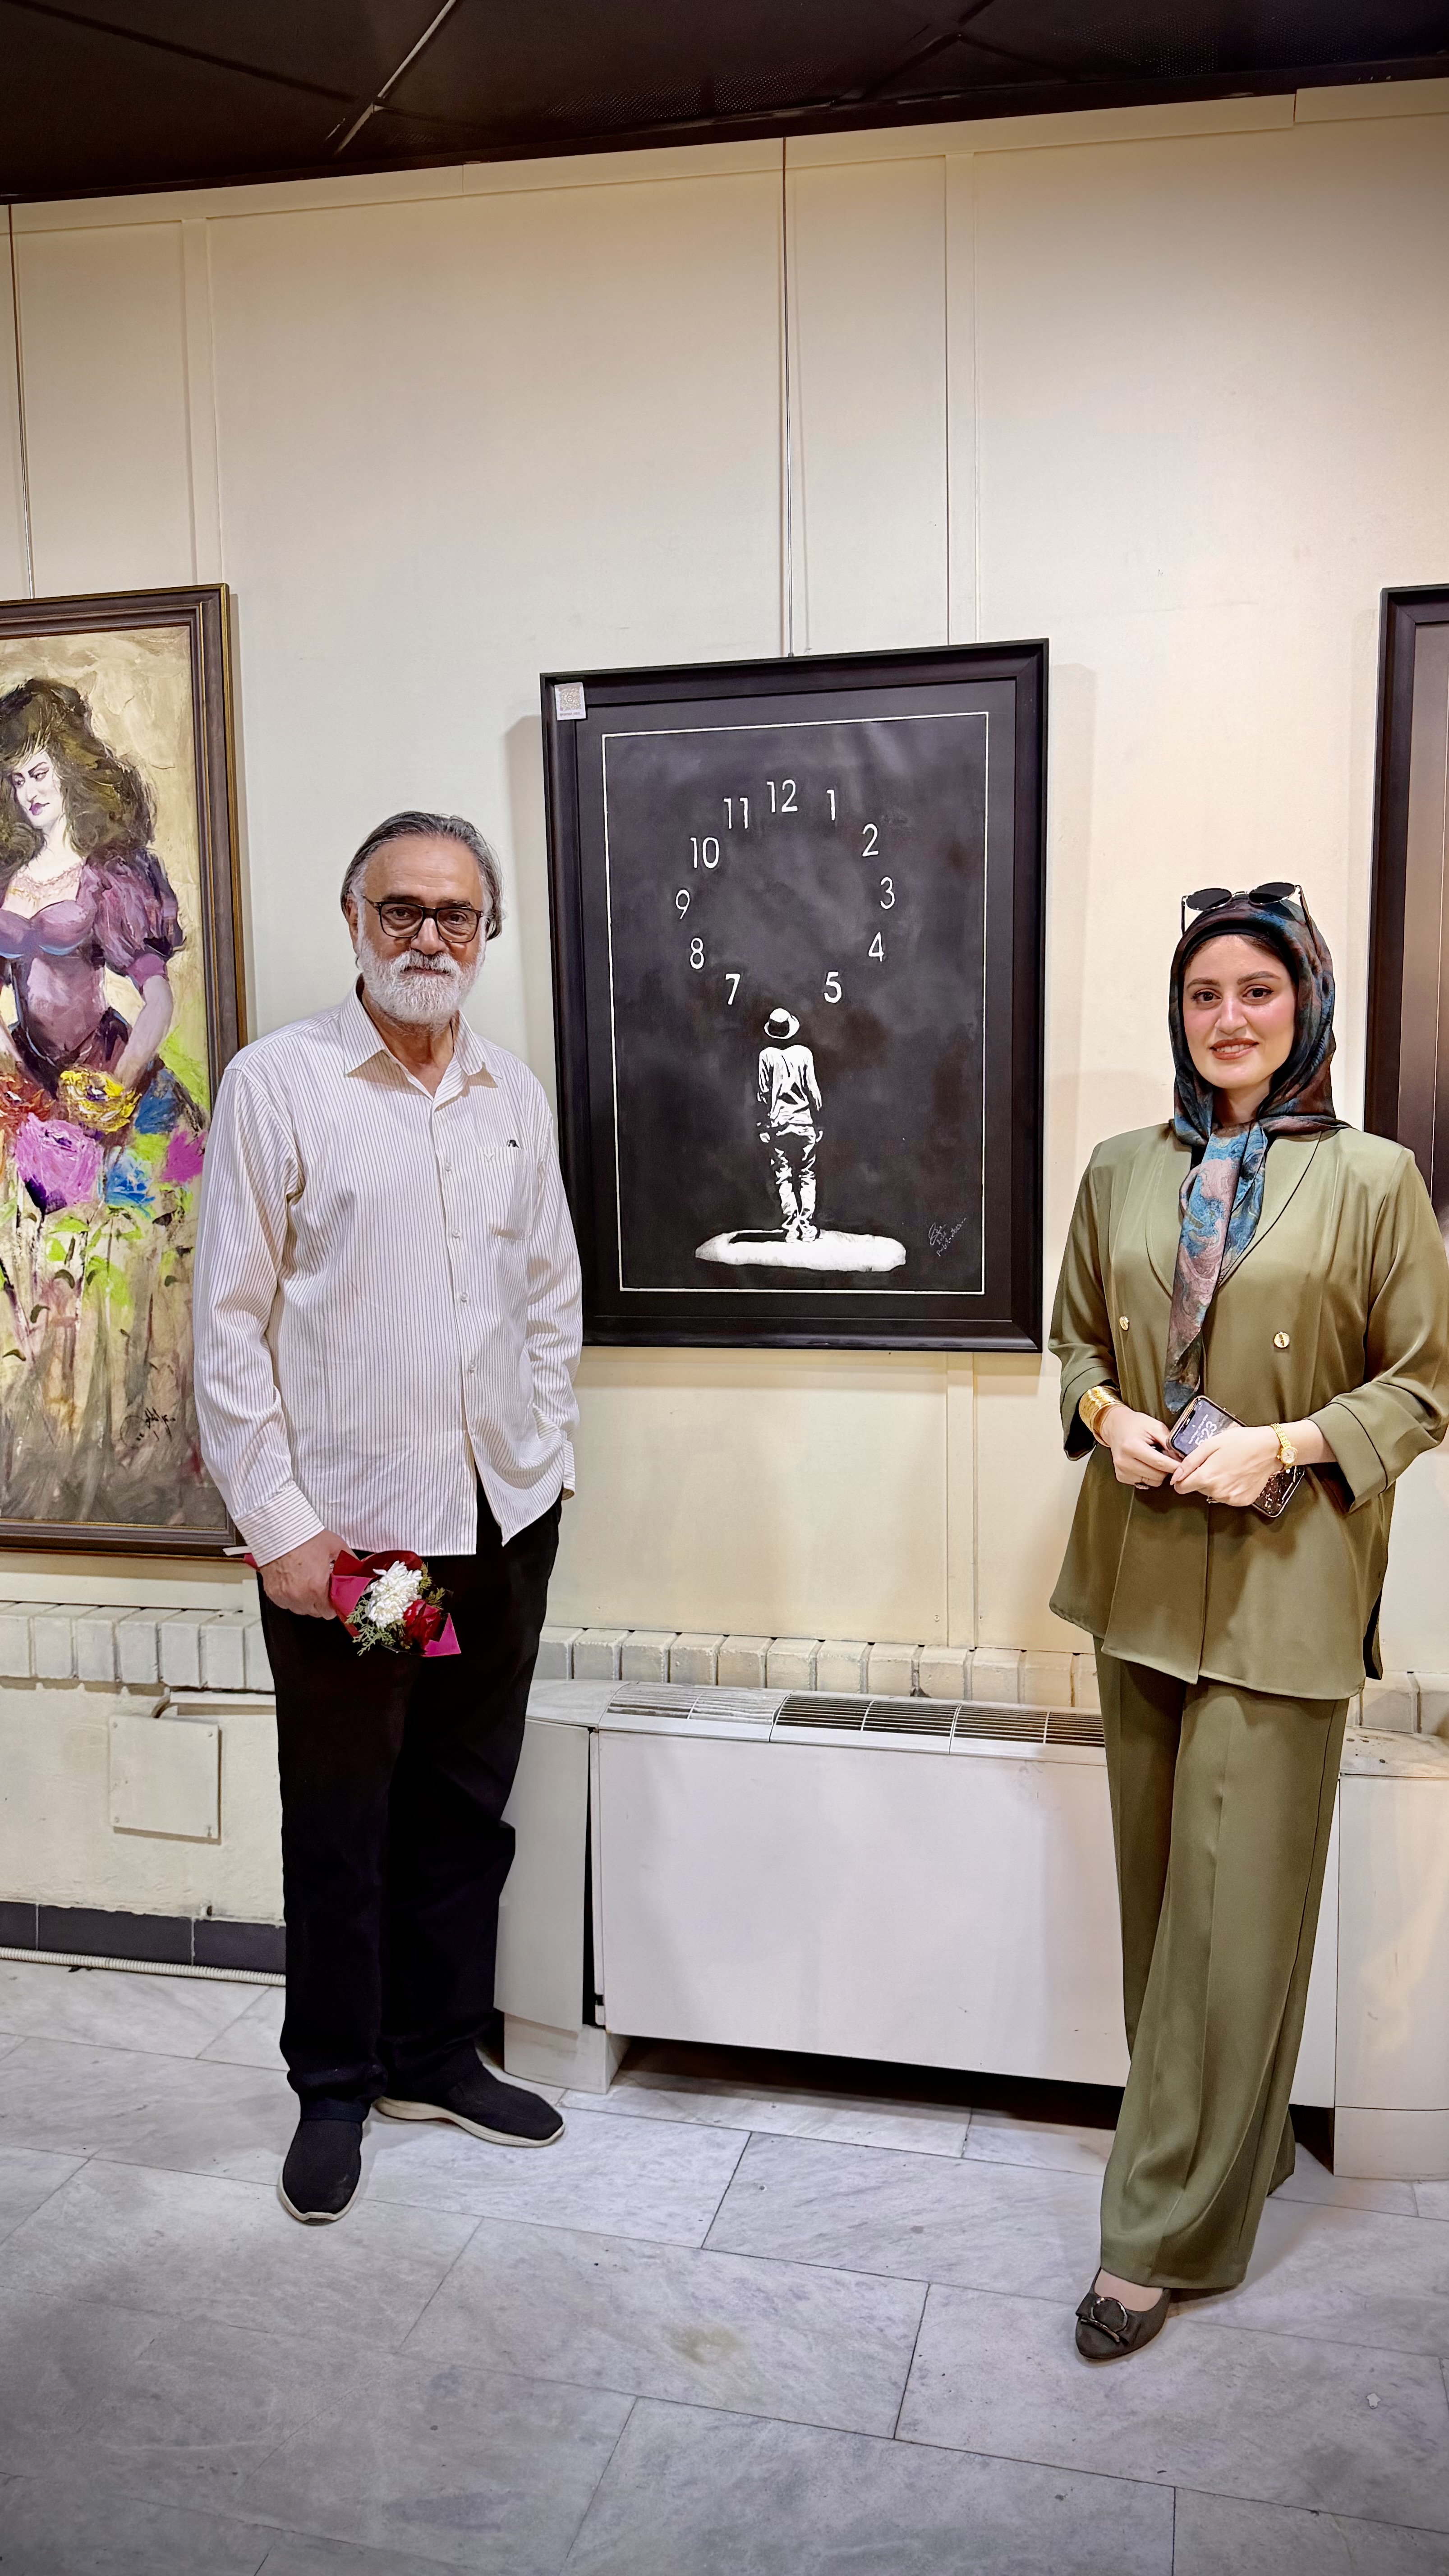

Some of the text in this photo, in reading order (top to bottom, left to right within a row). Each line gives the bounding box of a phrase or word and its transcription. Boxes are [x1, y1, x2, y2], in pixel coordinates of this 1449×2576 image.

[767, 779, 798, 813] 12
[827, 789, 836, 821] 1
[723, 797, 748, 829] 11
[690, 837, 719, 869] 10
[862, 823, 879, 857] 2
[676, 889, 690, 920] 9
[880, 877, 895, 909] 3
[690, 938, 704, 969] 8
[868, 932, 884, 962] 4
[725, 973, 741, 1005] 7
[824, 971, 842, 1003] 5
